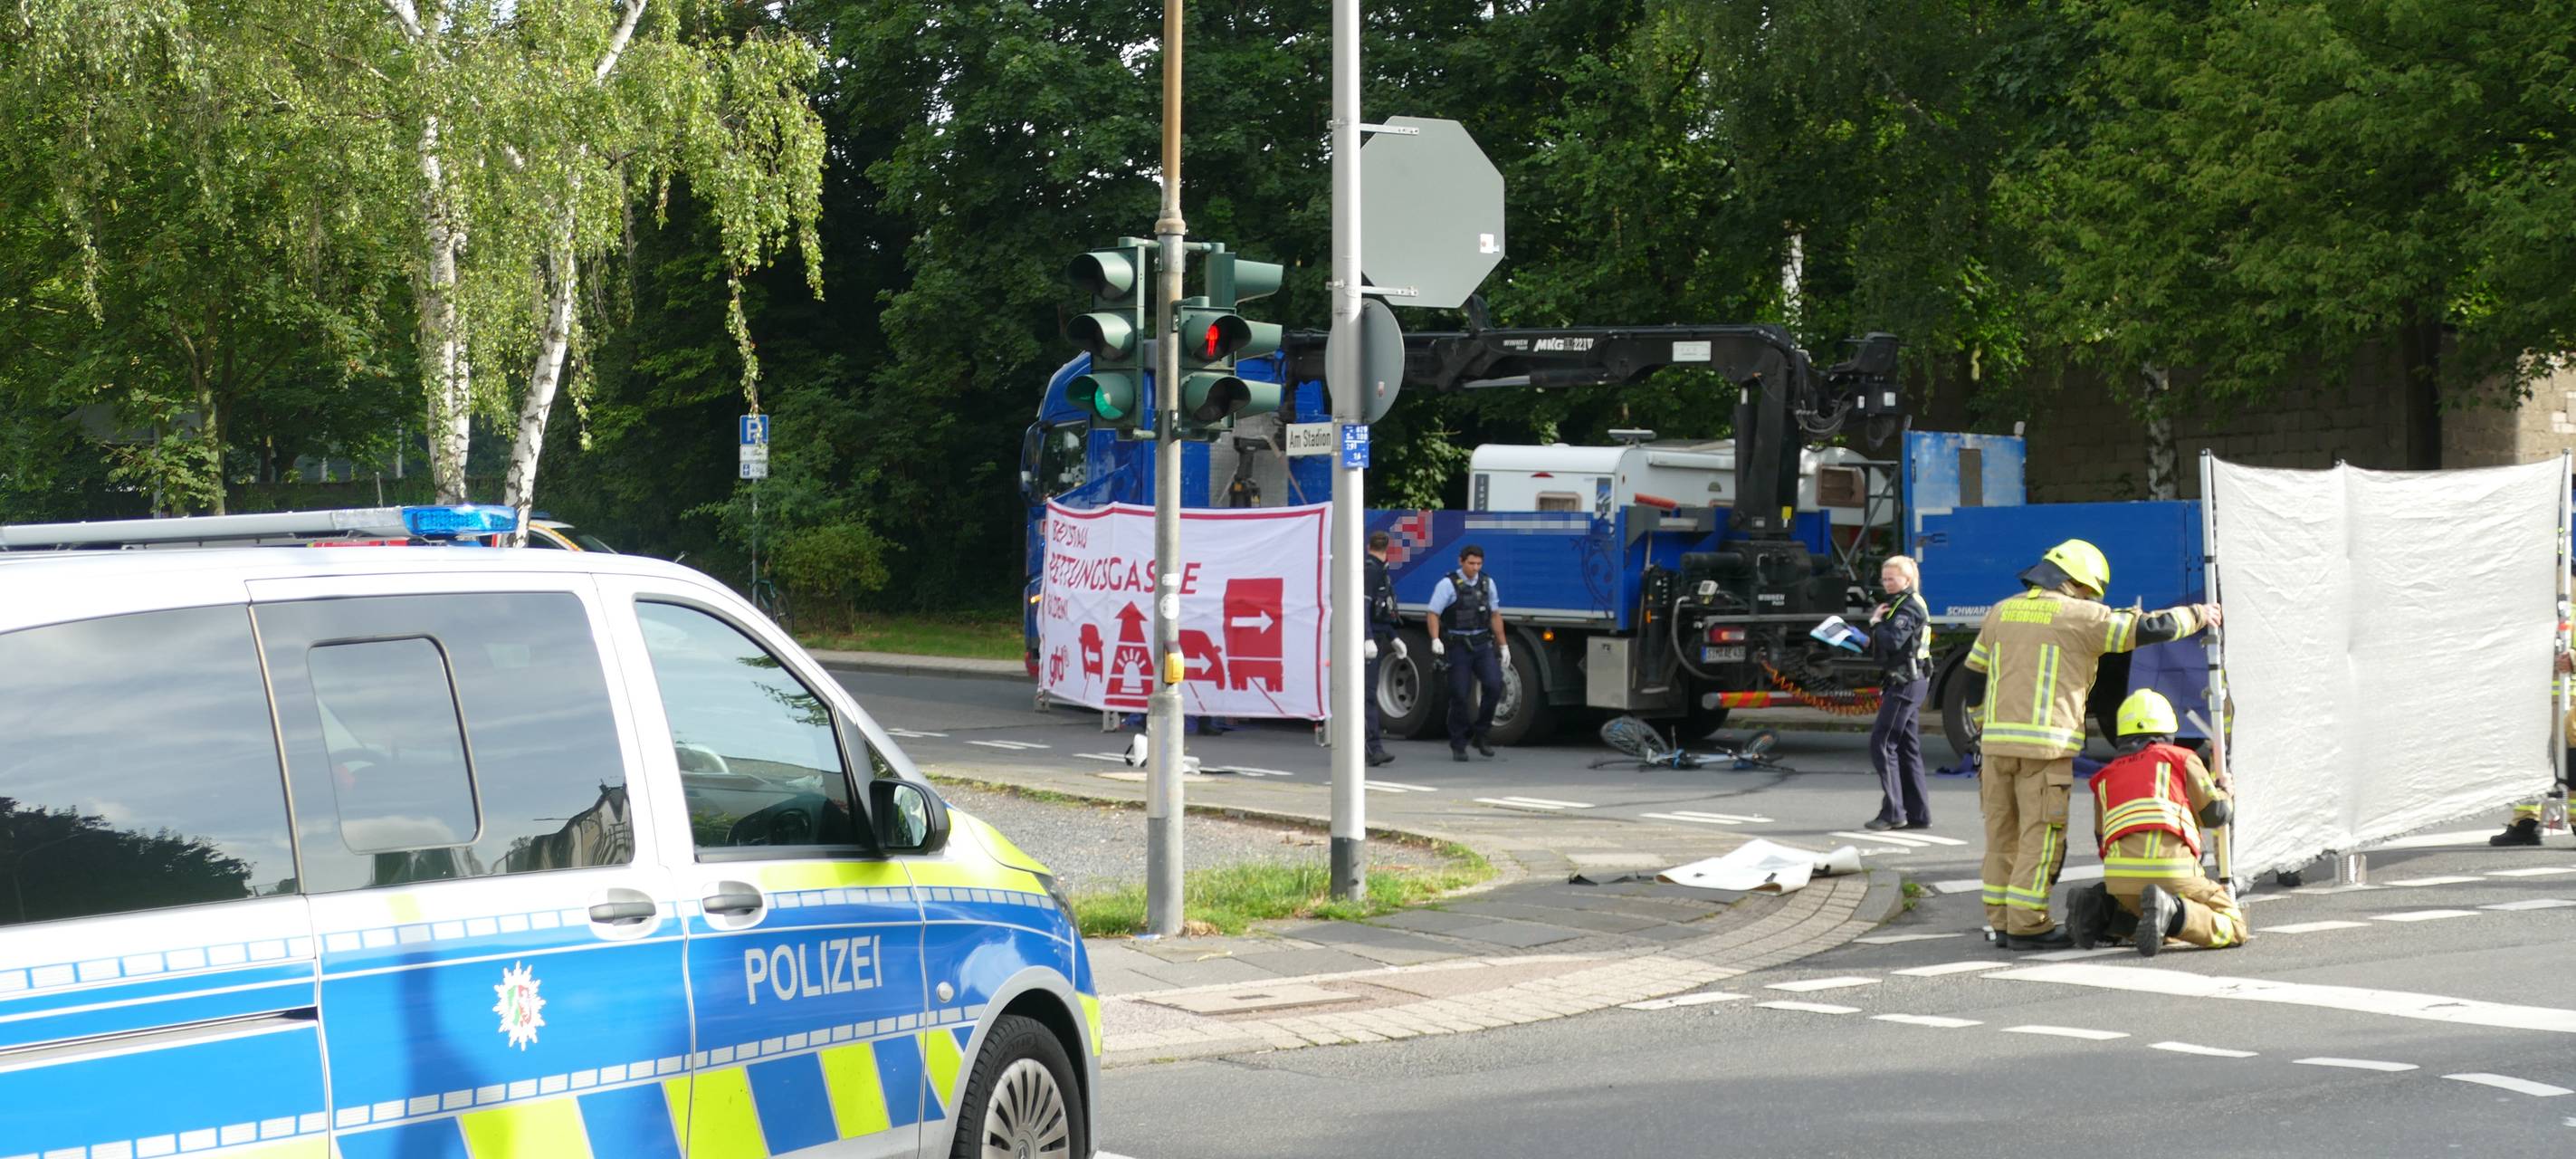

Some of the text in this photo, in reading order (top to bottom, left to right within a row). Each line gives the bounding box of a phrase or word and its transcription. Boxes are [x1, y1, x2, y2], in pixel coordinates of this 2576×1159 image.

[1533, 337, 1564, 352] MKG
[1289, 427, 1331, 448] Am Stadion
[1049, 551, 1202, 595] RETTUNGSGASE
[1999, 608, 2053, 625] SIEGBURG
[745, 935, 882, 1005] POLIZEI
